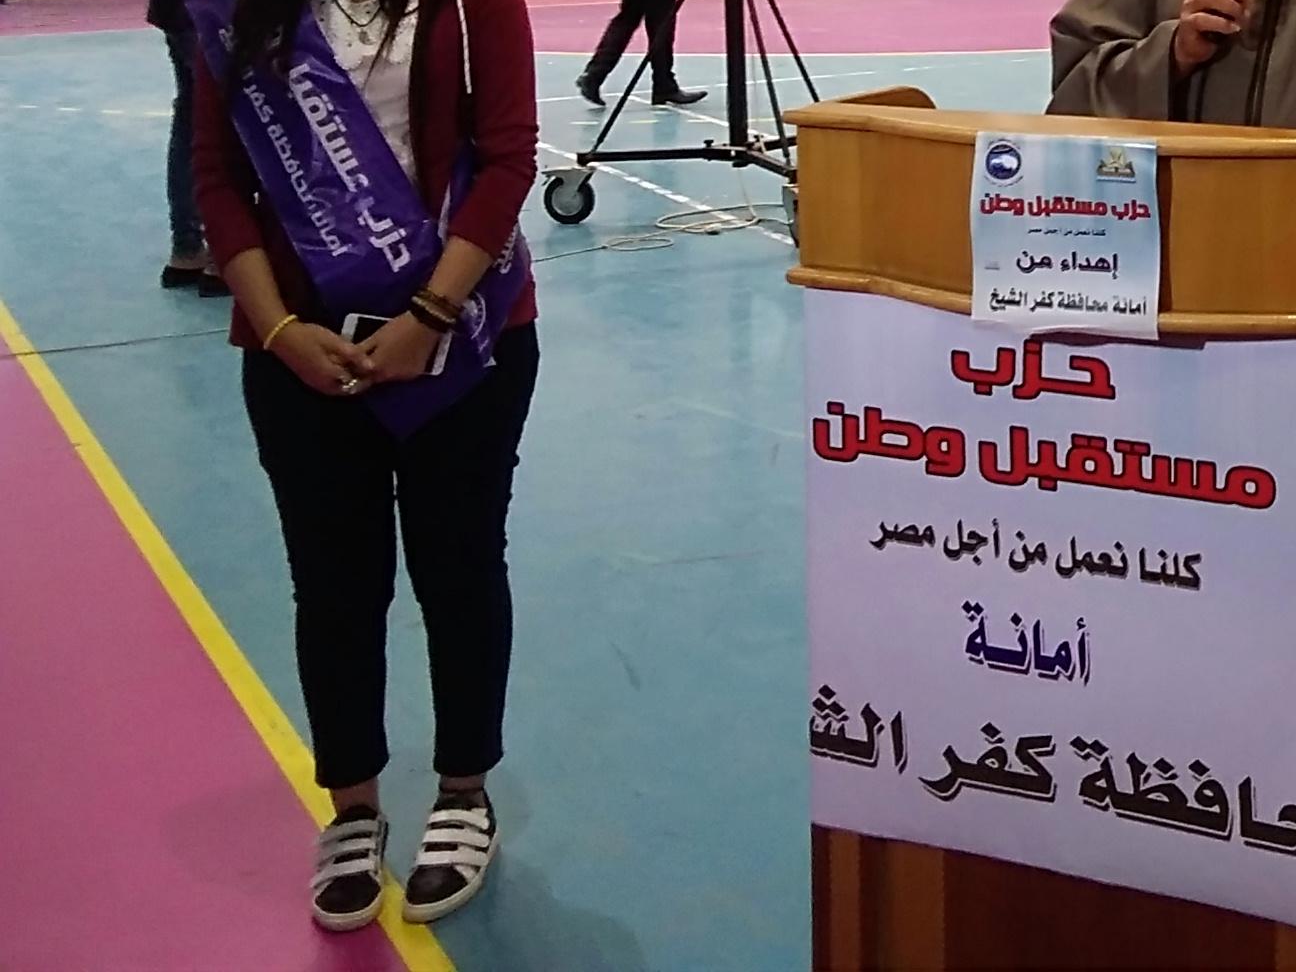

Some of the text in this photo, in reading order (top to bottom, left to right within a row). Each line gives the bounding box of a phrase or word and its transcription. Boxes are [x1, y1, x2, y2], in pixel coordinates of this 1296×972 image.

[358, 196, 412, 273] حزب
[980, 192, 1151, 221] حزب مستقبل وطن
[1016, 250, 1118, 279] إهداء من
[989, 287, 1028, 312] الشيخ
[1029, 290, 1054, 313] كفر
[1057, 291, 1108, 313] محافظة
[950, 340, 1117, 401] حزب
[812, 400, 1278, 510] مستقبل وطن
[869, 518, 1203, 593] كلنا نعمل من أجل مصر
[961, 599, 1091, 688] أمانة
[809, 683, 909, 775] الش
[917, 721, 1058, 805] كفر
